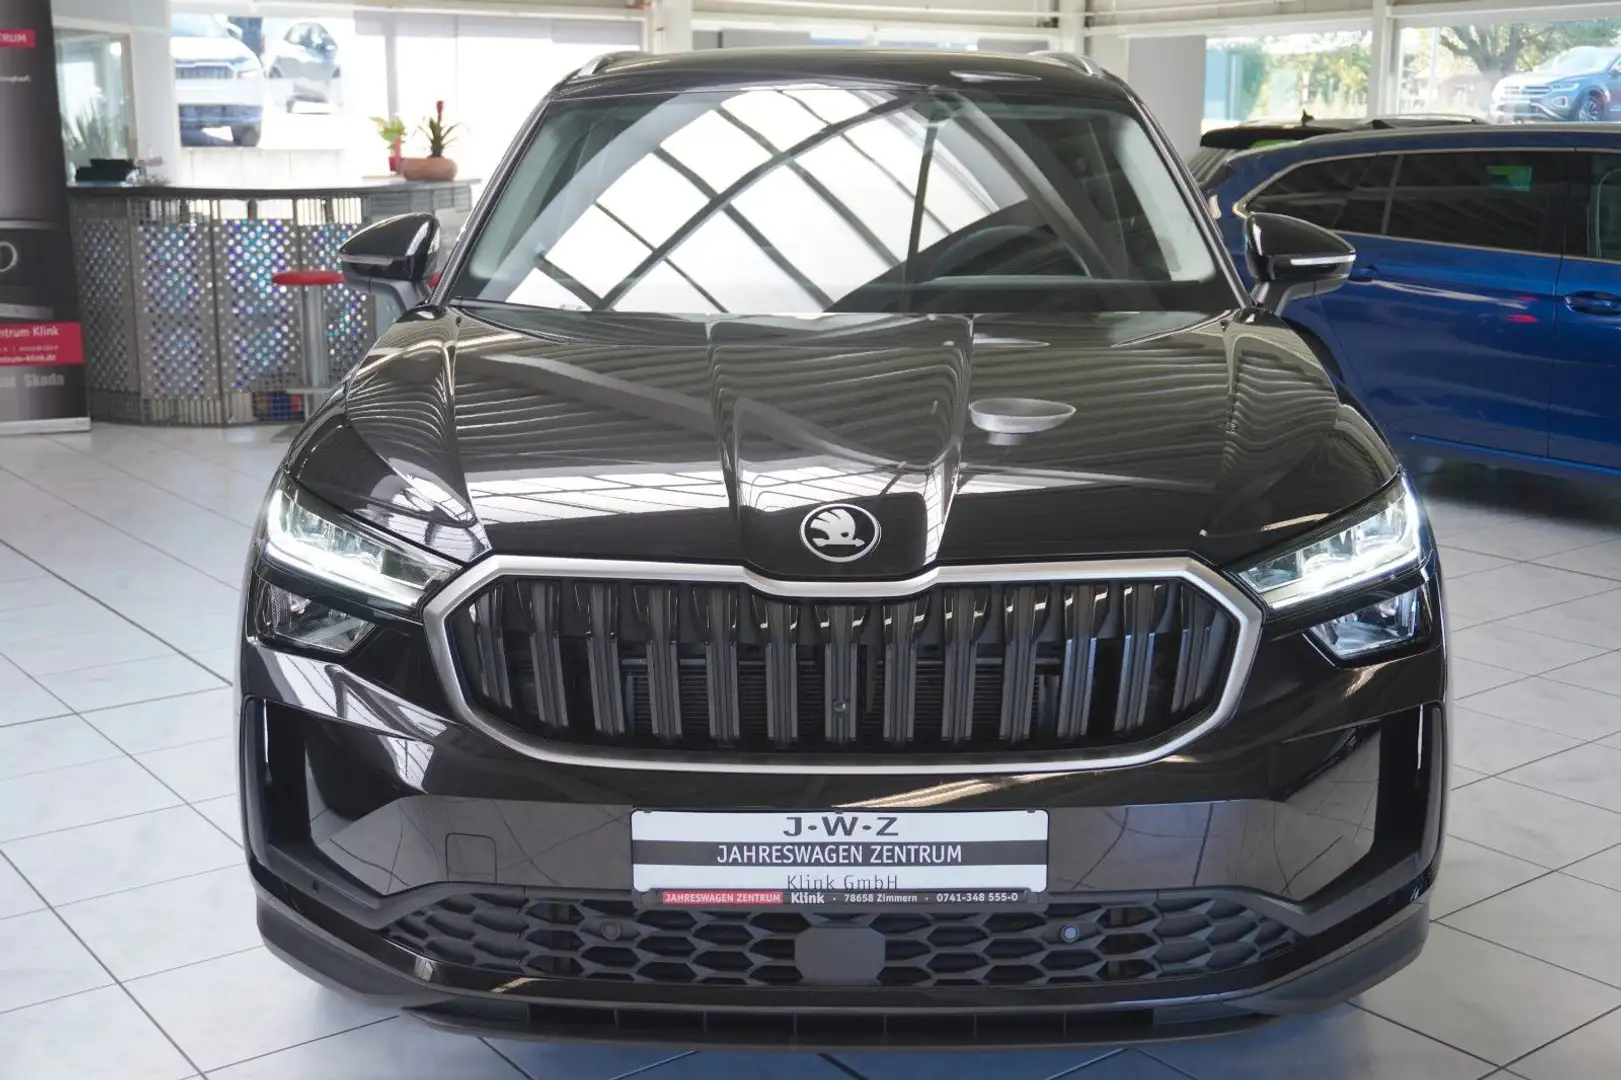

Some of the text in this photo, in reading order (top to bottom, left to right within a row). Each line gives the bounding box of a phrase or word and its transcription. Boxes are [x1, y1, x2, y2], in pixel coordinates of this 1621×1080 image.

[33, 325, 60, 337] Klink
[717, 845, 962, 864] JAHRESWAGEN ZENTRUM
[787, 875, 898, 890] Klink GmbH
[665, 892, 1018, 904] JAHRESWAGEN ZENTRUM Klink 78658 Zimmern 0741-348 555-0
